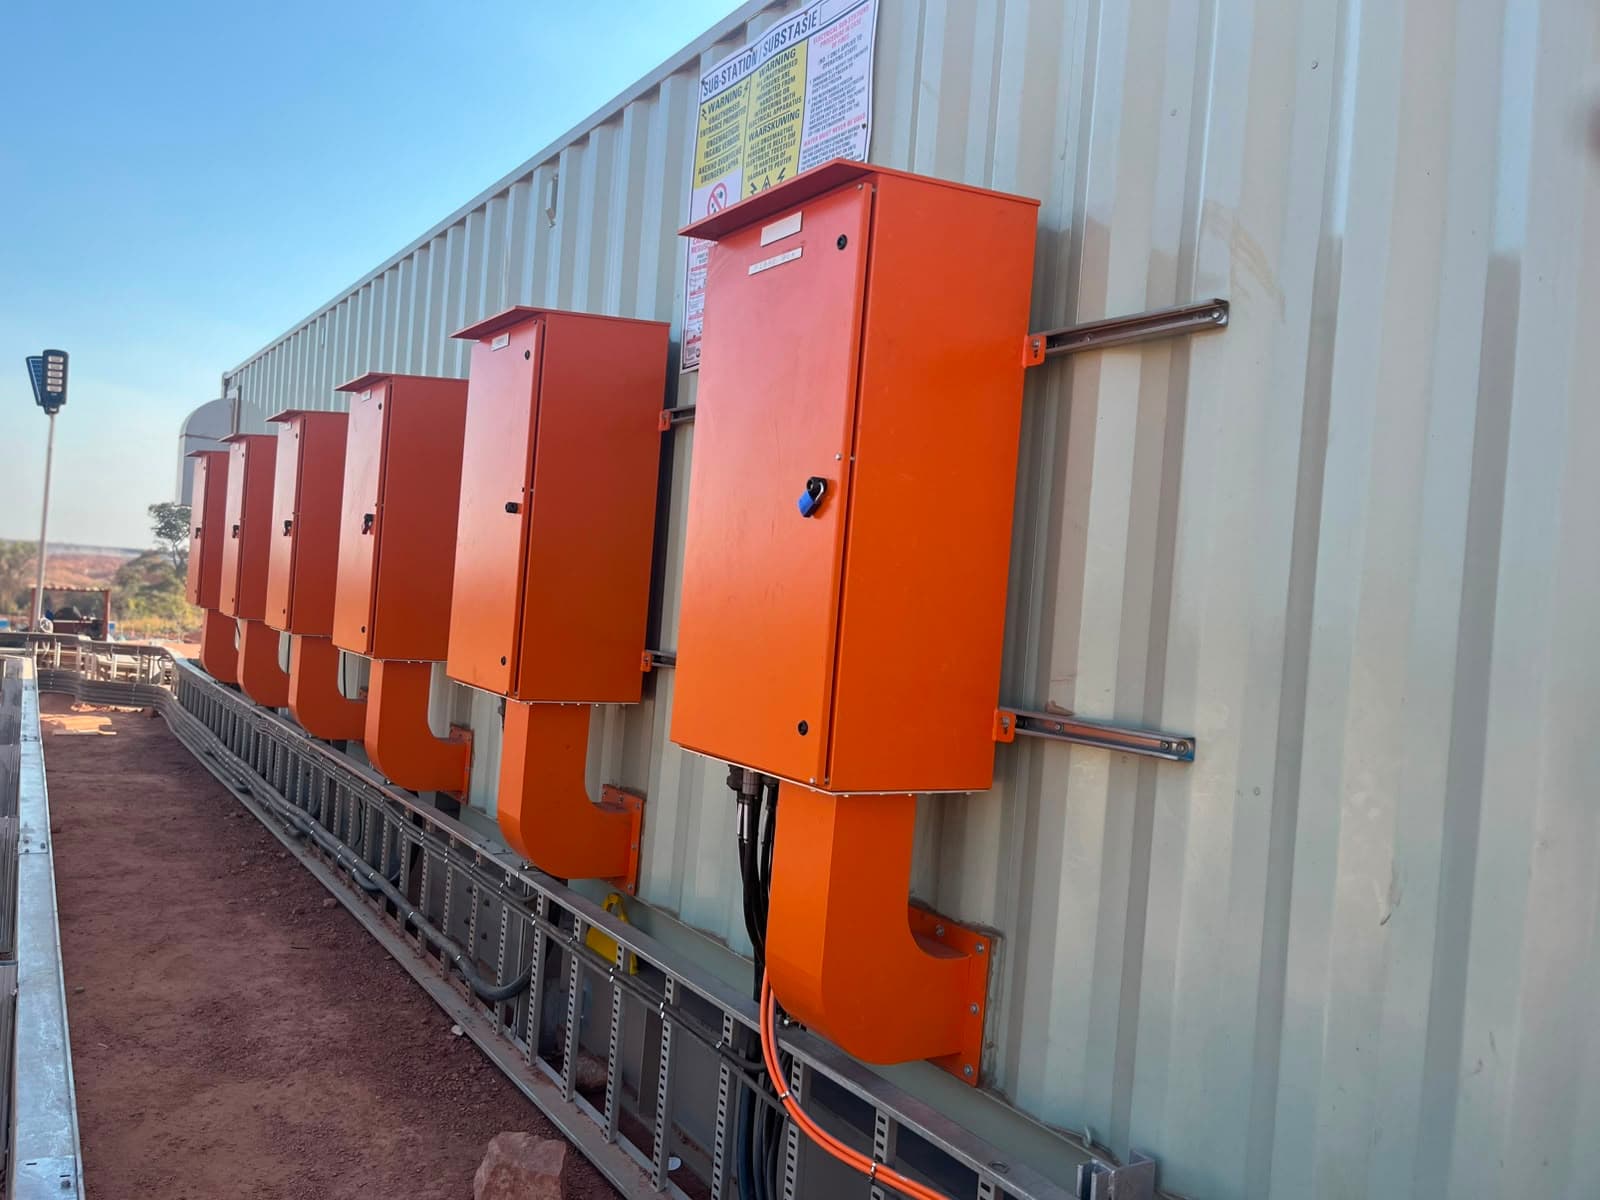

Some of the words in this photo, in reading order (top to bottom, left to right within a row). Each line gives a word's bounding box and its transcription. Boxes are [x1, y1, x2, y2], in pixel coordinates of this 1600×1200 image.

[703, 49, 757, 97] SUB-STATION
[763, 10, 817, 57] SUBSTASIE
[759, 48, 796, 78] WARNING
[706, 84, 742, 115] WARNING
[772, 95, 802, 116] APPARATUS
[748, 108, 800, 142] WAARSKUWING
